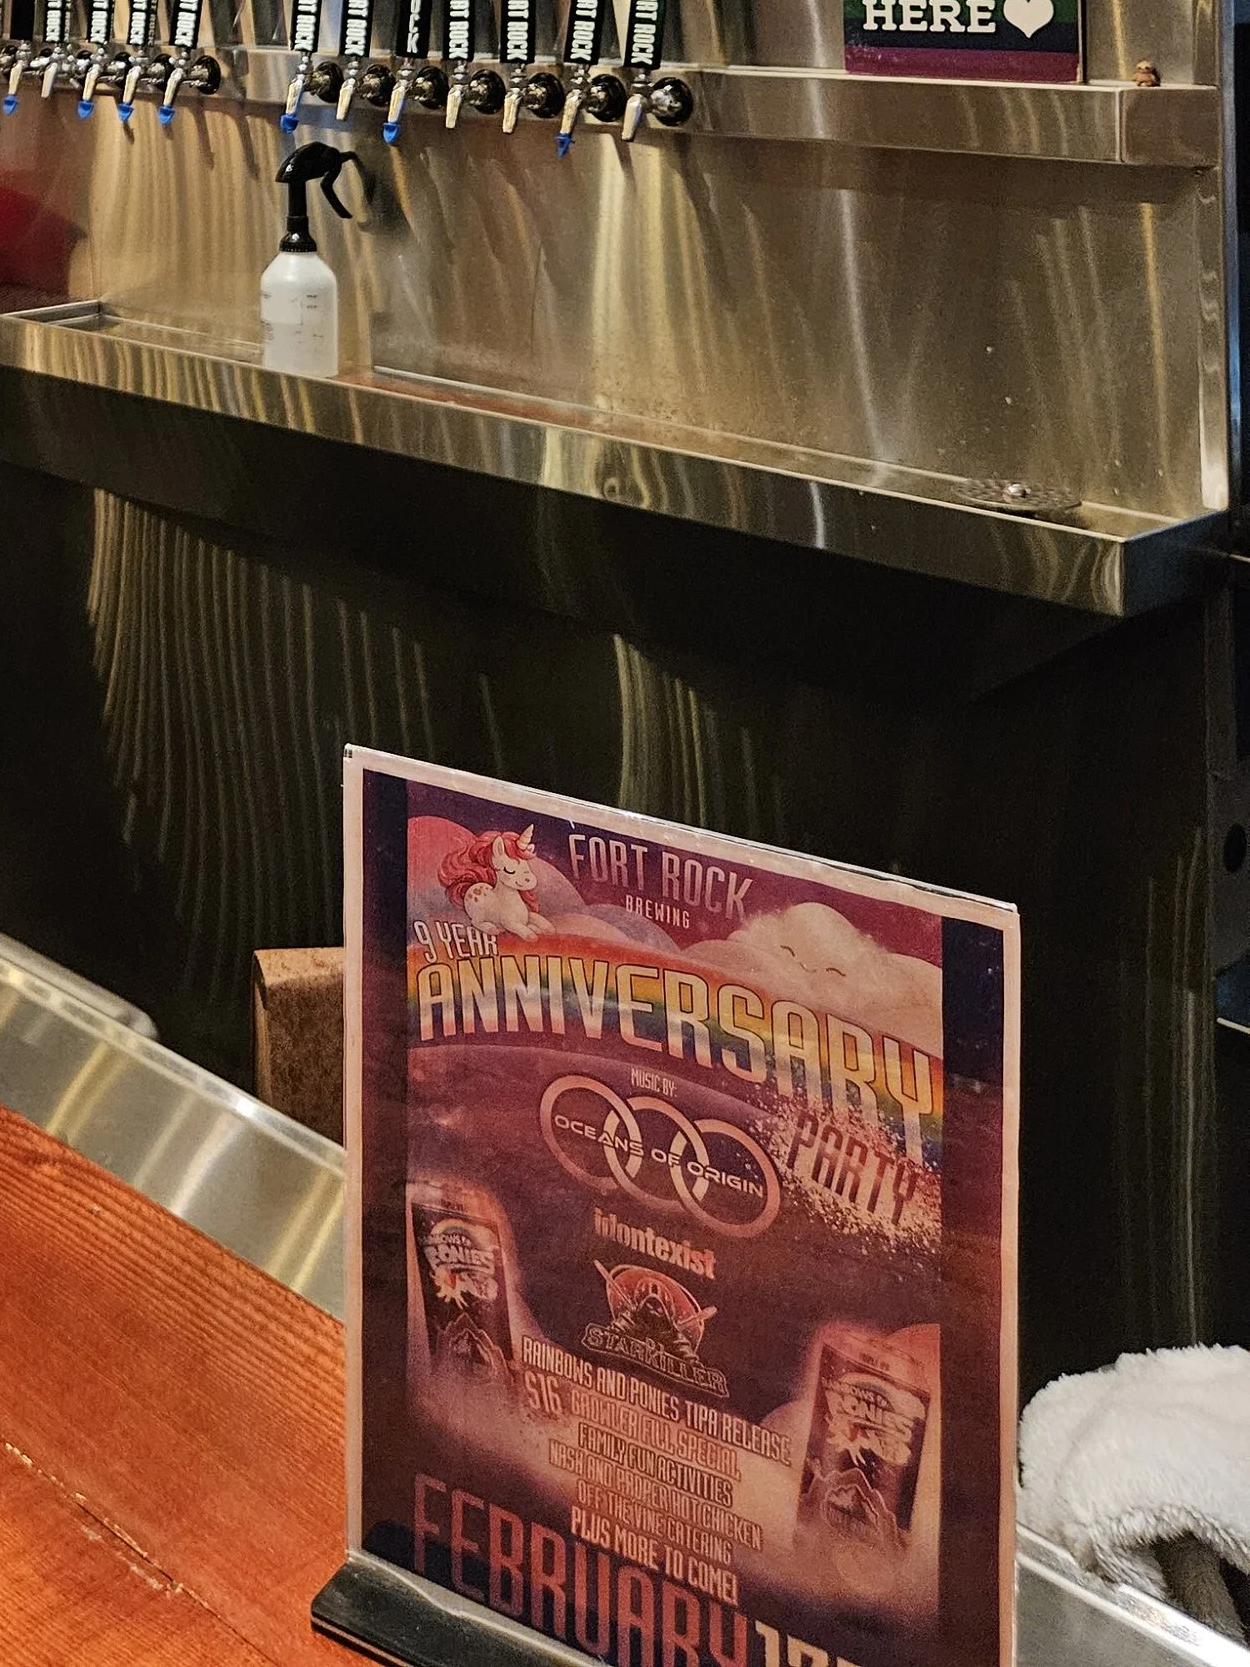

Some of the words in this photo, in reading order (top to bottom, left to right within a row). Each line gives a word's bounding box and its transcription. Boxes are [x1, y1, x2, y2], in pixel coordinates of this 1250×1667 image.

[295, 15, 317, 52] ROCK
[345, 19, 368, 57] ROCK
[448, 21, 470, 60] ROCK
[506, 21, 529, 62] ROCK
[570, 19, 594, 62] ROCK
[631, 21, 657, 66] ROCK
[568, 833, 649, 891] FORT
[661, 851, 755, 922] ROCK
[625, 894, 691, 930] BREWING
[413, 920, 438, 964] 9
[439, 921, 499, 960] YEAR
[416, 954, 935, 1167] ANNIVERSARY
[631, 1068, 661, 1093] MUSIC
[662, 1078, 678, 1098] BY:
[554, 1114, 645, 1157] OCEANS
[650, 1148, 682, 1168] OF
[686, 1161, 764, 1199] ORIGIN
[786, 1114, 921, 1228] PARTY
[523, 1336, 592, 1389] RAINBOWS
[597, 1367, 626, 1400] AND
[629, 1377, 679, 1422] PONIES
[685, 1400, 718, 1437] TIPA
[722, 1413, 791, 1466] RELEASE
[586, 1326, 728, 1392] STARKILLER
[571, 1389, 638, 1439] GROWLER
[640, 1414, 674, 1455] FILL
[678, 1430, 741, 1481] SPECIAL
[578, 1422, 626, 1465] FAMILY
[628, 1442, 656, 1478] FUN
[657, 1455, 733, 1508] ACTIVITIES
[577, 1479, 604, 1510] OFF
[608, 1491, 631, 1525] THE
[633, 1502, 664, 1537] VINE
[667, 1517, 733, 1565] CATERING
[587, 1454, 613, 1488] AND
[615, 1467, 669, 1512] PROPER
[671, 1489, 700, 1524] HOT
[702, 1503, 763, 1551] CHICKEN
[413, 1474, 749, 1667] FEBRUARY
[571, 1505, 610, 1549] PLUS
[614, 1524, 659, 1571] MORE
[664, 1544, 684, 1581] TO
[688, 1555, 739, 1607] COME!
